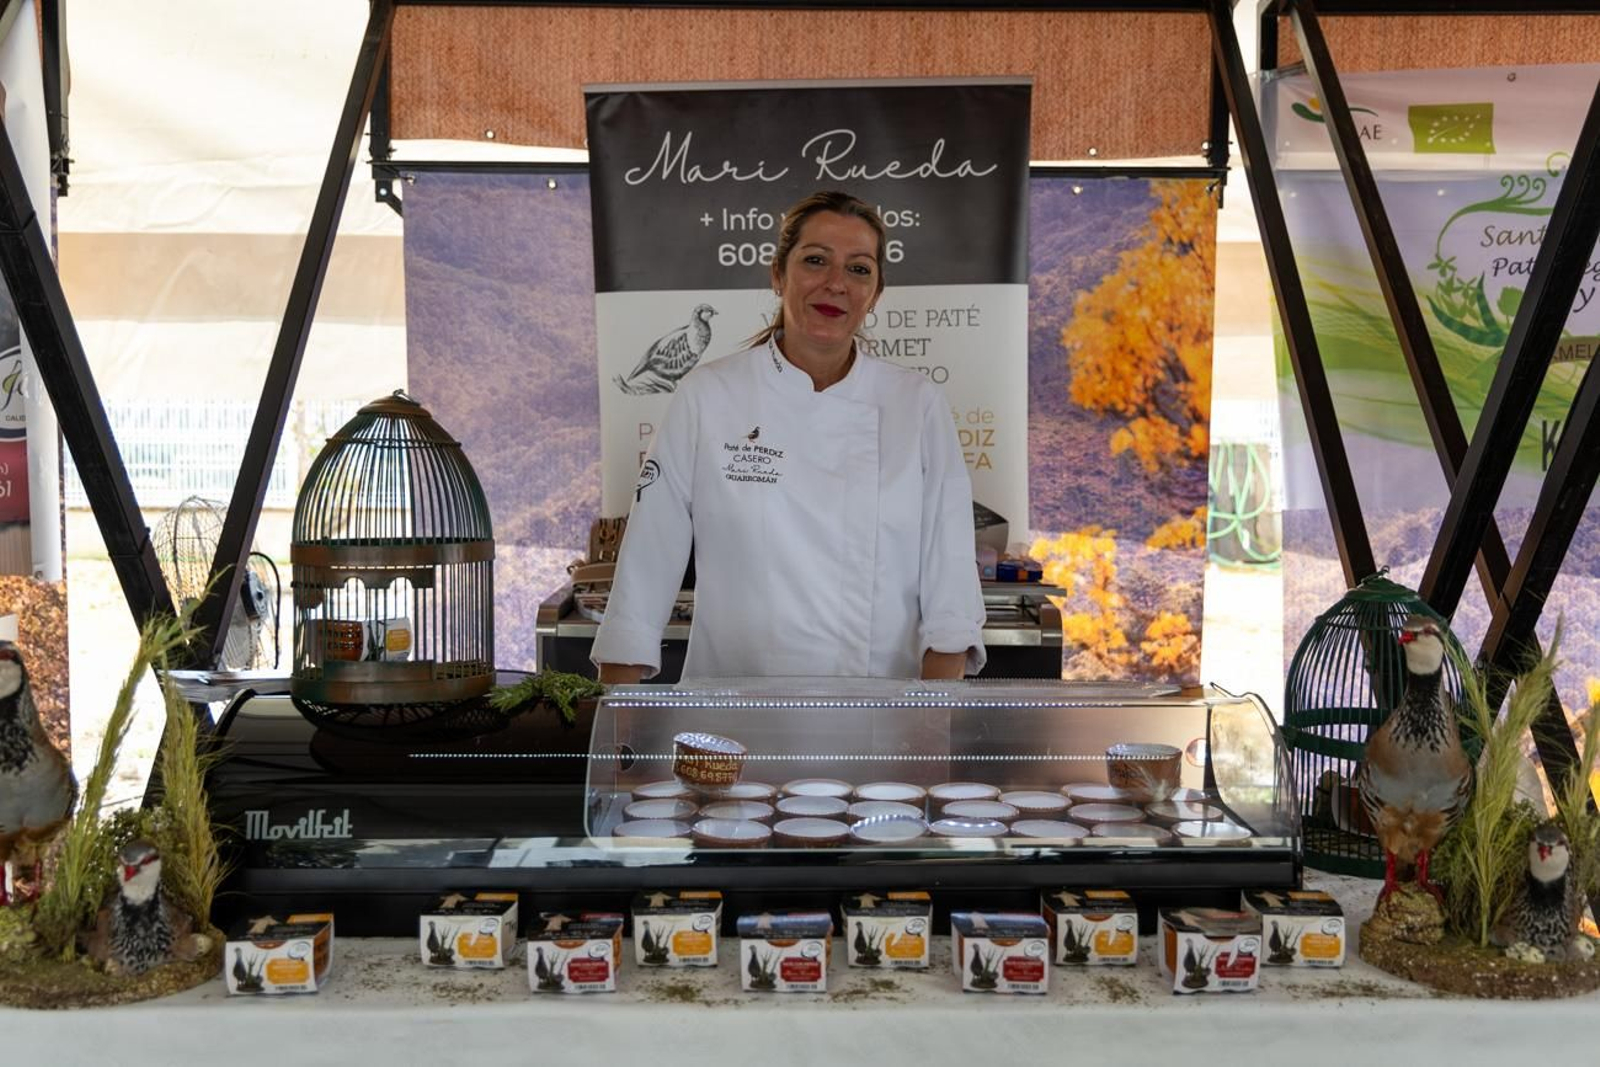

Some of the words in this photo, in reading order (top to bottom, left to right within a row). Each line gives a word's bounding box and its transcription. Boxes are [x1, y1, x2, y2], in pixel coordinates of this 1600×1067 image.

[625, 131, 788, 185] Mari
[801, 129, 997, 181] Rueda
[722, 208, 773, 230] Info
[1481, 225, 1547, 249] Sant
[887, 310, 916, 328] DE
[926, 304, 980, 327] PATÉ
[966, 407, 994, 424] de
[733, 454, 771, 464] CASERO
[742, 443, 751, 452] de
[754, 445, 783, 458] PERDIZ
